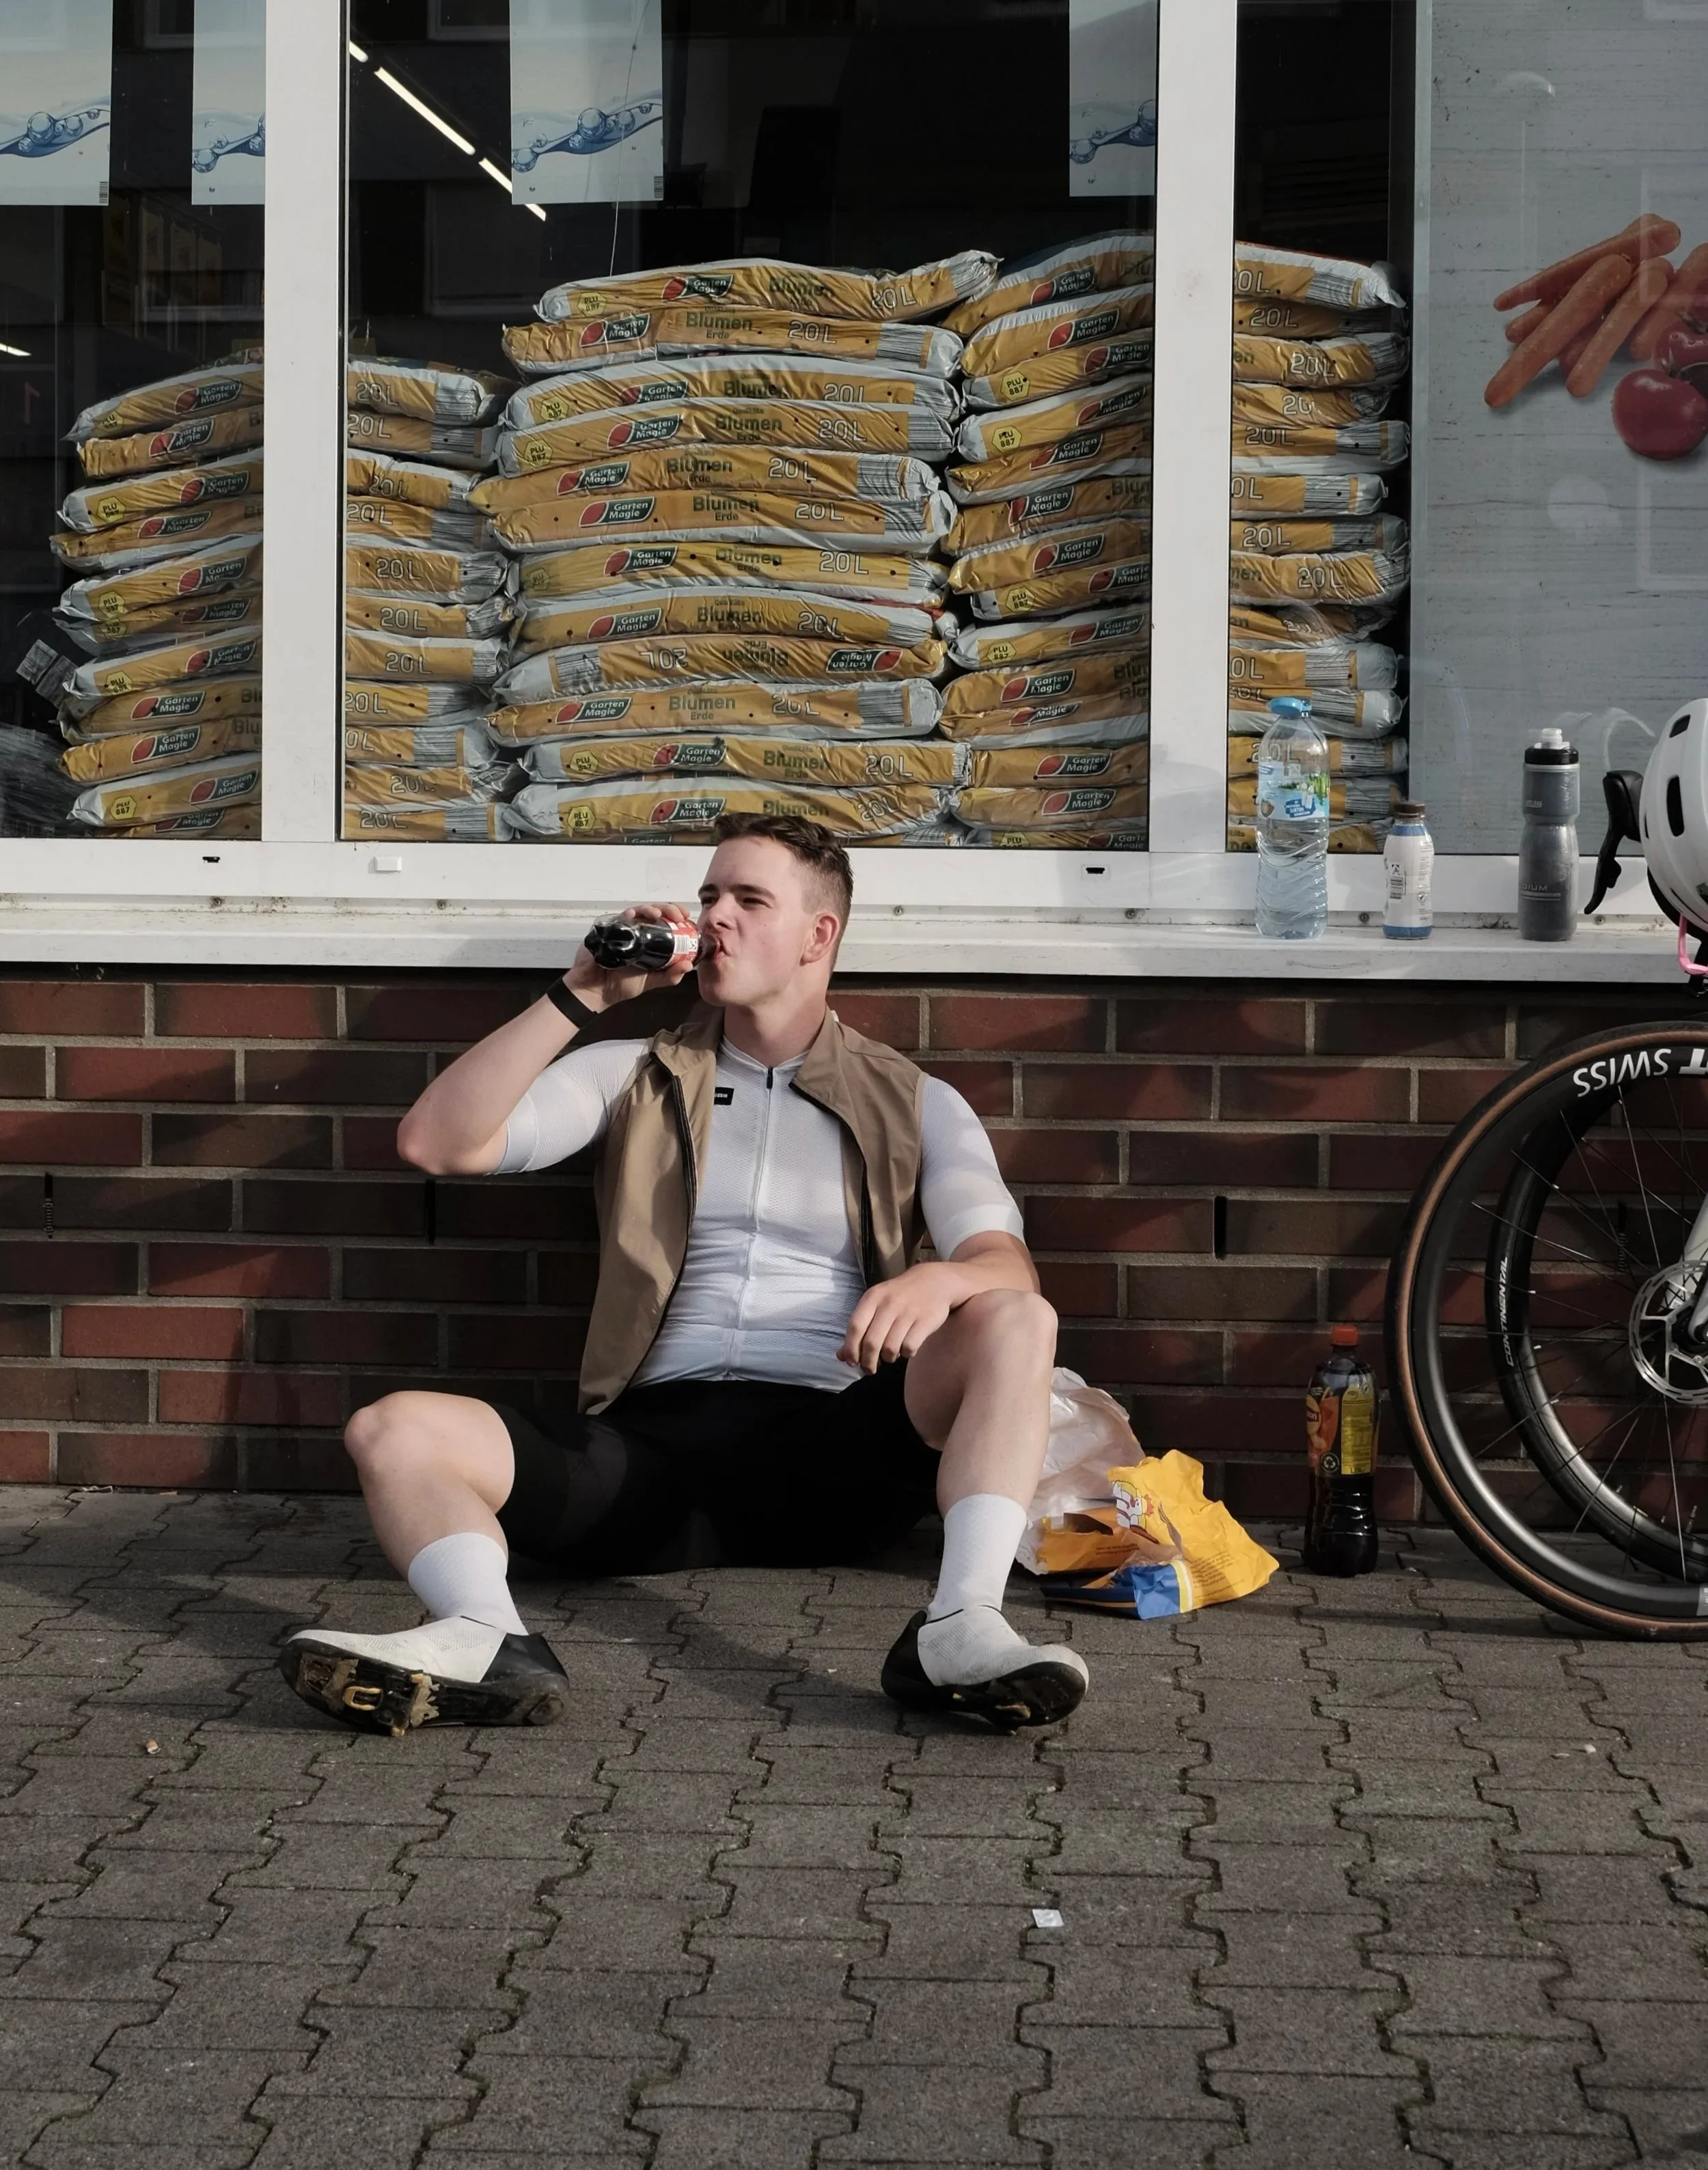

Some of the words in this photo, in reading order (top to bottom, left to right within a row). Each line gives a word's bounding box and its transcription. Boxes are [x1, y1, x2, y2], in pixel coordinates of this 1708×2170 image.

[583, 295, 598, 305] PLU
[685, 312, 754, 330] Blumen
[1080, 315, 1114, 329] Garten
[706, 331, 730, 340] Erde
[1077, 325, 1107, 338] Magie
[1115, 344, 1150, 354] Garten
[1112, 352, 1142, 363] Magie
[1007, 379, 1021, 388] PLU
[204, 383, 236, 395] Garten
[648, 385, 682, 395] Garten
[1008, 385, 1024, 396] 887
[201, 392, 229, 403] Magie
[547, 402, 560, 411] PLU
[640, 420, 674, 430] Garten
[715, 414, 782, 431] Blumen
[636, 428, 667, 438] Magie
[999, 430, 1014, 439] PLU
[1000, 437, 1015, 448] 887
[1063, 438, 1097, 450] Garten
[530, 446, 545, 454] PLU
[1059, 446, 1089, 459] Magie
[666, 457, 732, 473] Blumen
[590, 466, 623, 478] Garten
[210, 477, 243, 486] Garten
[585, 474, 616, 484] Magie
[1034, 492, 1068, 504] Garten
[102, 503, 118, 512] PLU
[614, 502, 648, 510] Garten
[693, 496, 759, 512] Blumen
[1030, 500, 1061, 512] Magie
[609, 509, 640, 519] Magie
[715, 512, 739, 521] Erde
[1064, 538, 1099, 552] Garten
[637, 550, 671, 558] Garten
[1060, 547, 1091, 560] Magie
[633, 558, 663, 566] Magie
[208, 562, 242, 575] Garten
[103, 597, 118, 607] PLU
[1012, 593, 1027, 602] PLU
[621, 614, 655, 624] Garten
[698, 607, 762, 622] Blumen
[617, 622, 648, 633] Magie
[1104, 618, 1139, 629] Garten
[841, 653, 872, 662] Magie
[832, 661, 867, 670] Garten
[111, 676, 124, 687] PLU
[1034, 674, 1069, 686] Garten
[165, 695, 198, 705] Garten
[590, 700, 624, 709] Garten
[669, 696, 736, 711] Blumen
[160, 702, 191, 713] Magie
[586, 707, 616, 717] Magie
[691, 712, 714, 721] Erde
[162, 732, 195, 745] Garten
[159, 740, 189, 753] Magie
[687, 746, 721, 755] Garten
[576, 756, 591, 765] PLU
[681, 754, 712, 763] Magie
[1072, 756, 1106, 765] Garten
[1066, 763, 1098, 773] Magie
[785, 769, 808, 778] Erde
[218, 780, 245, 795] Magie
[1076, 792, 1110, 801] Garten
[685, 801, 718, 810] Garten
[1071, 799, 1102, 809] Magie
[115, 806, 130, 815] 887
[680, 809, 710, 818] Magie
[1006, 836, 1022, 844] PLU
[1573, 1048, 1672, 1097] SWISS
[1499, 1256, 1515, 1367] CONTINENTAL
